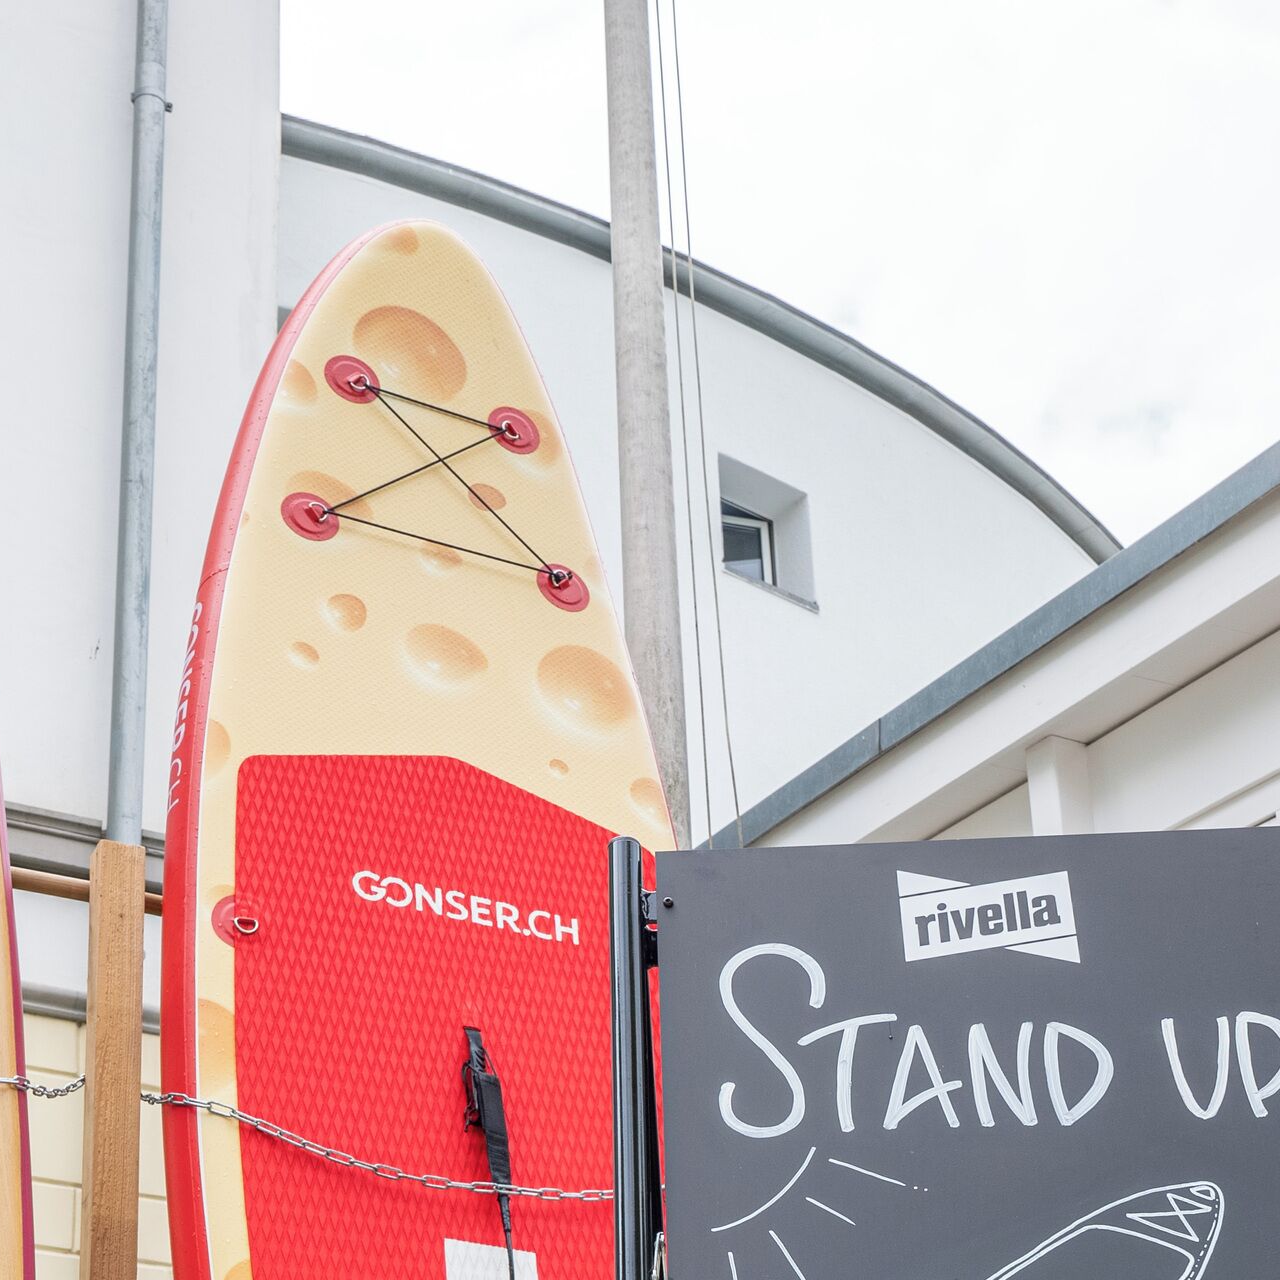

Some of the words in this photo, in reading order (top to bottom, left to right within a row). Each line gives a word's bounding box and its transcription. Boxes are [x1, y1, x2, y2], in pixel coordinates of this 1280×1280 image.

[351, 870, 580, 945] GONSER.CH
[914, 890, 1062, 947] rivella
[718, 942, 1115, 1139] STAND
